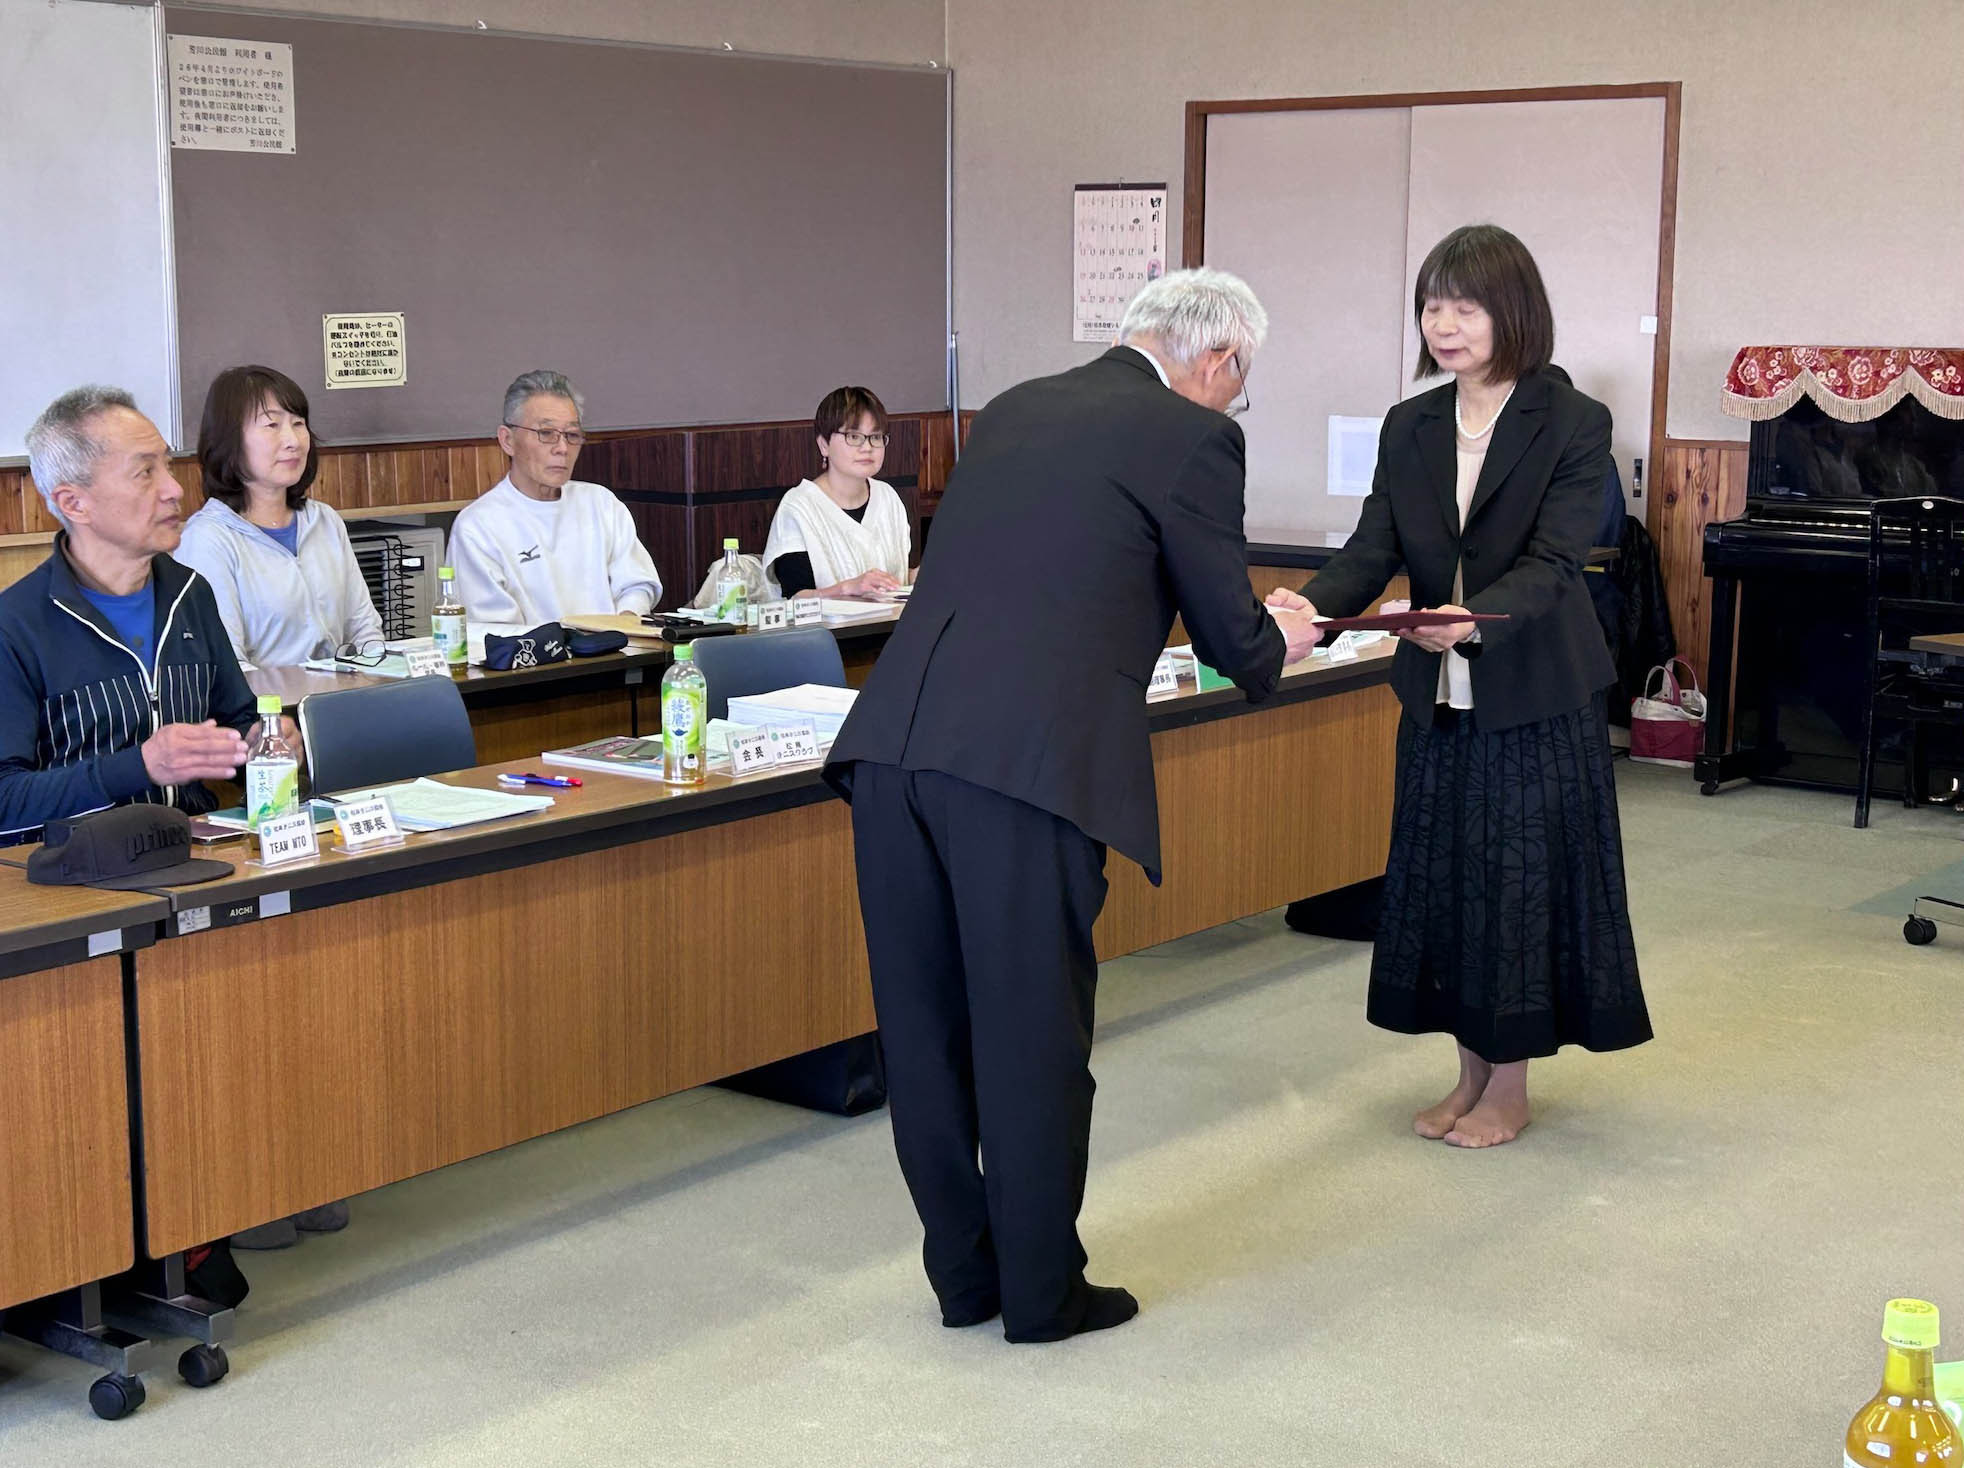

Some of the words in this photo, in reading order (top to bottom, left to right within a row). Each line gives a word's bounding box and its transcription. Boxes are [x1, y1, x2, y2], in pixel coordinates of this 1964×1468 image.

[742, 746, 765, 762] 会長
[349, 816, 387, 836] 理事長
[269, 840, 288, 855] TEAM
[229, 905, 253, 917] AICHI
